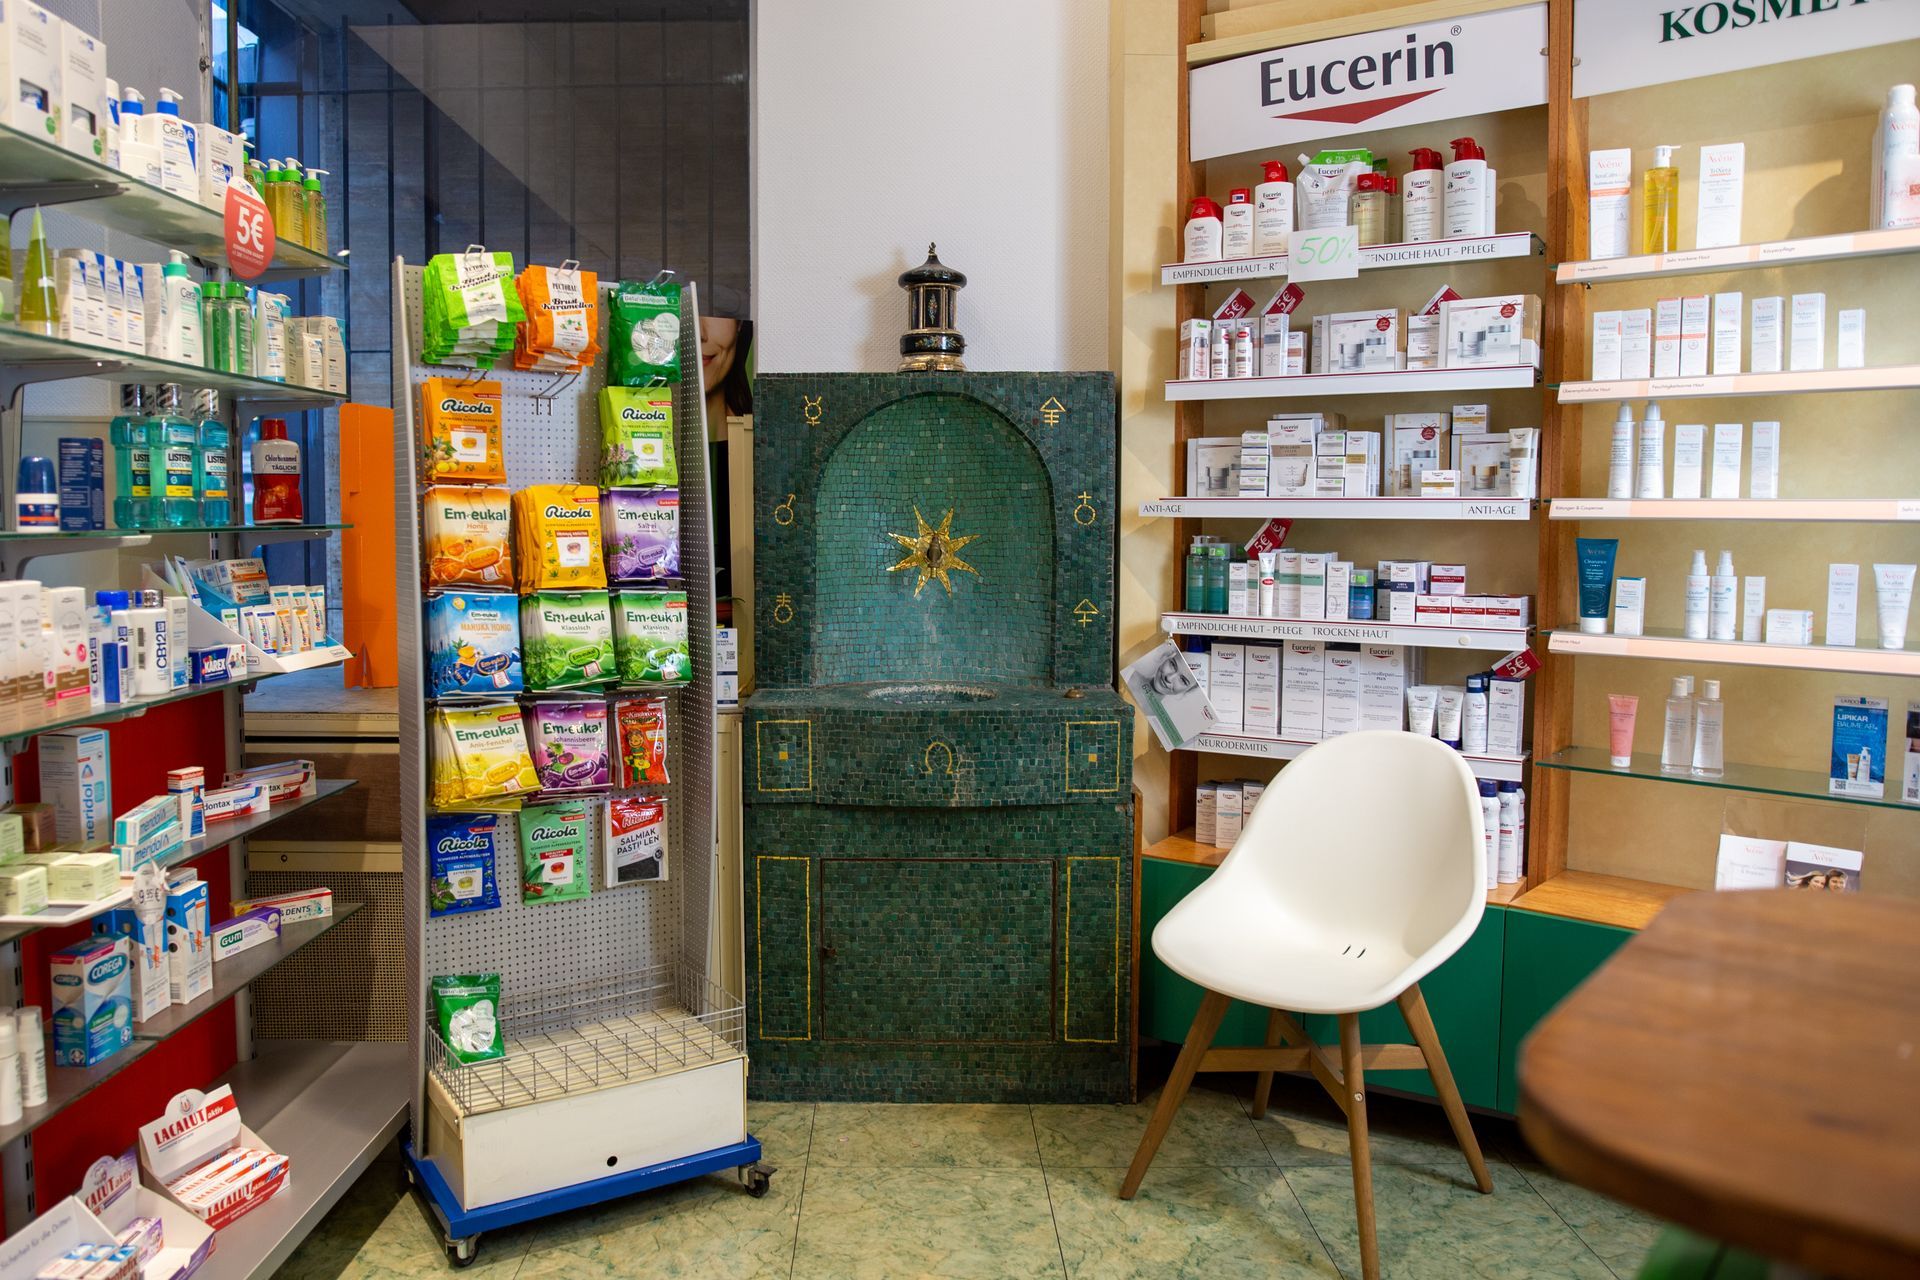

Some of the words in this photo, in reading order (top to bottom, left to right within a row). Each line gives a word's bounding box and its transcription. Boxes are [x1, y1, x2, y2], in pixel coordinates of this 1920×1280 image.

[1659, 0, 1885, 43] KOSM
[236, 205, 264, 252] 5€
[1296, 233, 1354, 265] 50%
[1366, 249, 1421, 263] INDLICHE
[1423, 247, 1451, 258] HAUT
[1461, 243, 1496, 255] PFLEGE
[1172, 263, 1235, 280] EMPFINDLICHE
[1236, 262, 1261, 277] HAUT
[1224, 299, 1243, 318] 5€
[1276, 290, 1294, 311] 5€
[441, 398, 493, 414] Ricola
[622, 407, 666, 421] Ricola
[545, 505, 592, 519] Ricola
[1142, 504, 1183, 514] ANTI-AGE
[1467, 505, 1517, 515] ANTI-AGE
[1254, 533, 1270, 552] 5€
[1176, 620, 1238, 634] EMPFINDLICHE
[1239, 623, 1264, 634] HAUT
[1272, 625, 1304, 636] PFLEGE
[1312, 626, 1361, 638] TROCKENE
[1362, 629, 1390, 639] HAUT
[156, 631, 167, 669] CB12
[1217, 650, 1237, 658] Eucerin
[1291, 643, 1316, 652] Eucerin
[1369, 647, 1395, 656] Eucerin
[90, 644, 99, 684] CB12
[1251, 652, 1271, 660] Eucerin
[1331, 657, 1353, 665] Eucerin
[1505, 655, 1528, 676] 5€
[1837, 713, 1869, 722] LIPIKAR
[1197, 738, 1268, 752] NEURODERMITIS
[531, 826, 578, 842] Ricola
[620, 827, 656, 846] SALMIAK
[438, 836, 489, 852] Ricola
[285, 905, 312, 916] DENTS
[91, 956, 123, 980] COREGA
[153, 1108, 206, 1145] LACALUT
[207, 1181, 253, 1217] LACALUT
